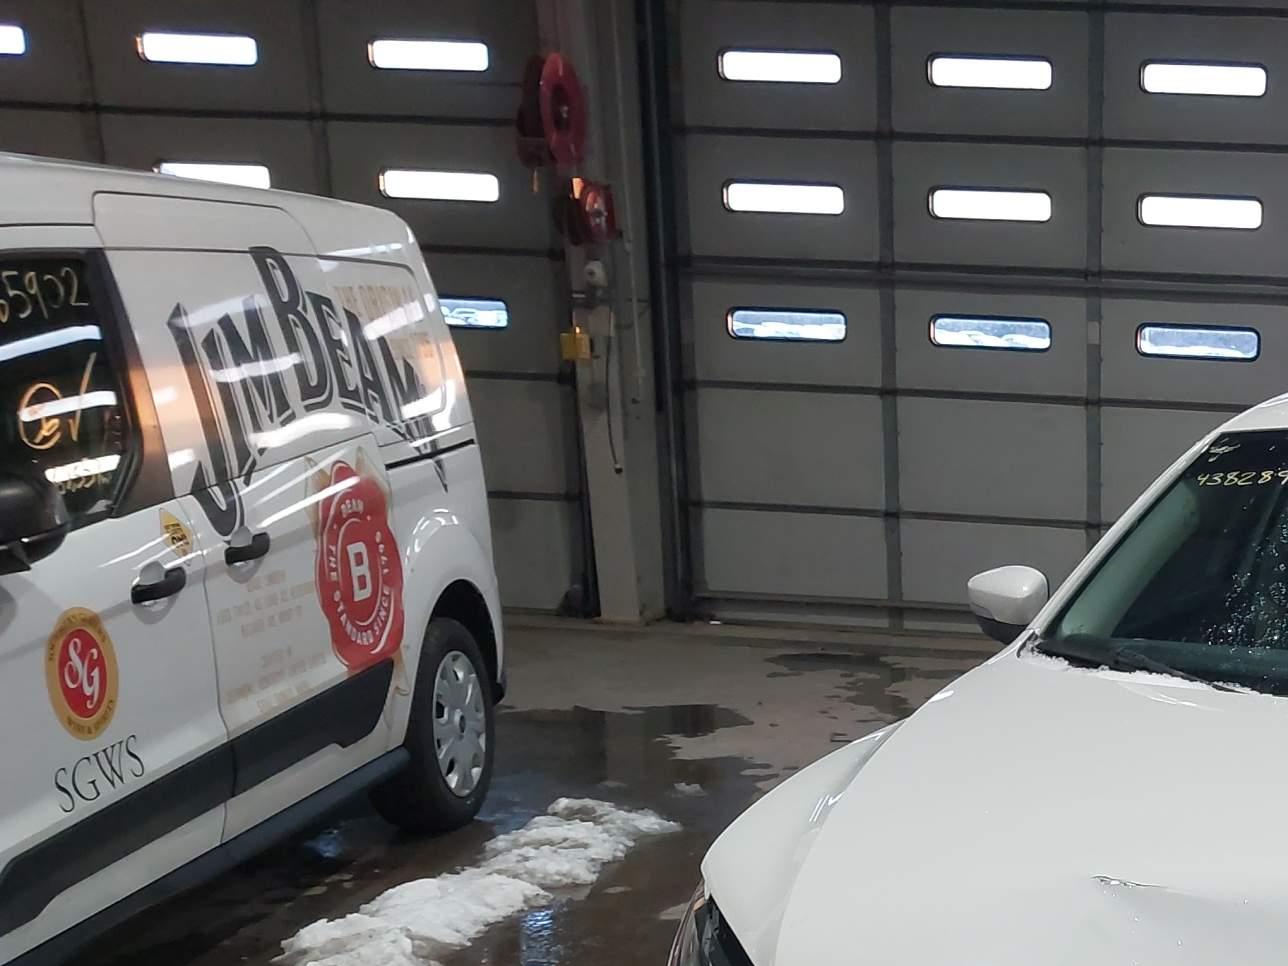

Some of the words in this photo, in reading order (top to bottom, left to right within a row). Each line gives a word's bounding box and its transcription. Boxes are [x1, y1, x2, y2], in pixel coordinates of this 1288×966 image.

[167, 301, 298, 542] JIM
[249, 246, 449, 493] BEAM
[346, 541, 372, 602] B
[54, 734, 145, 813] SGWS
